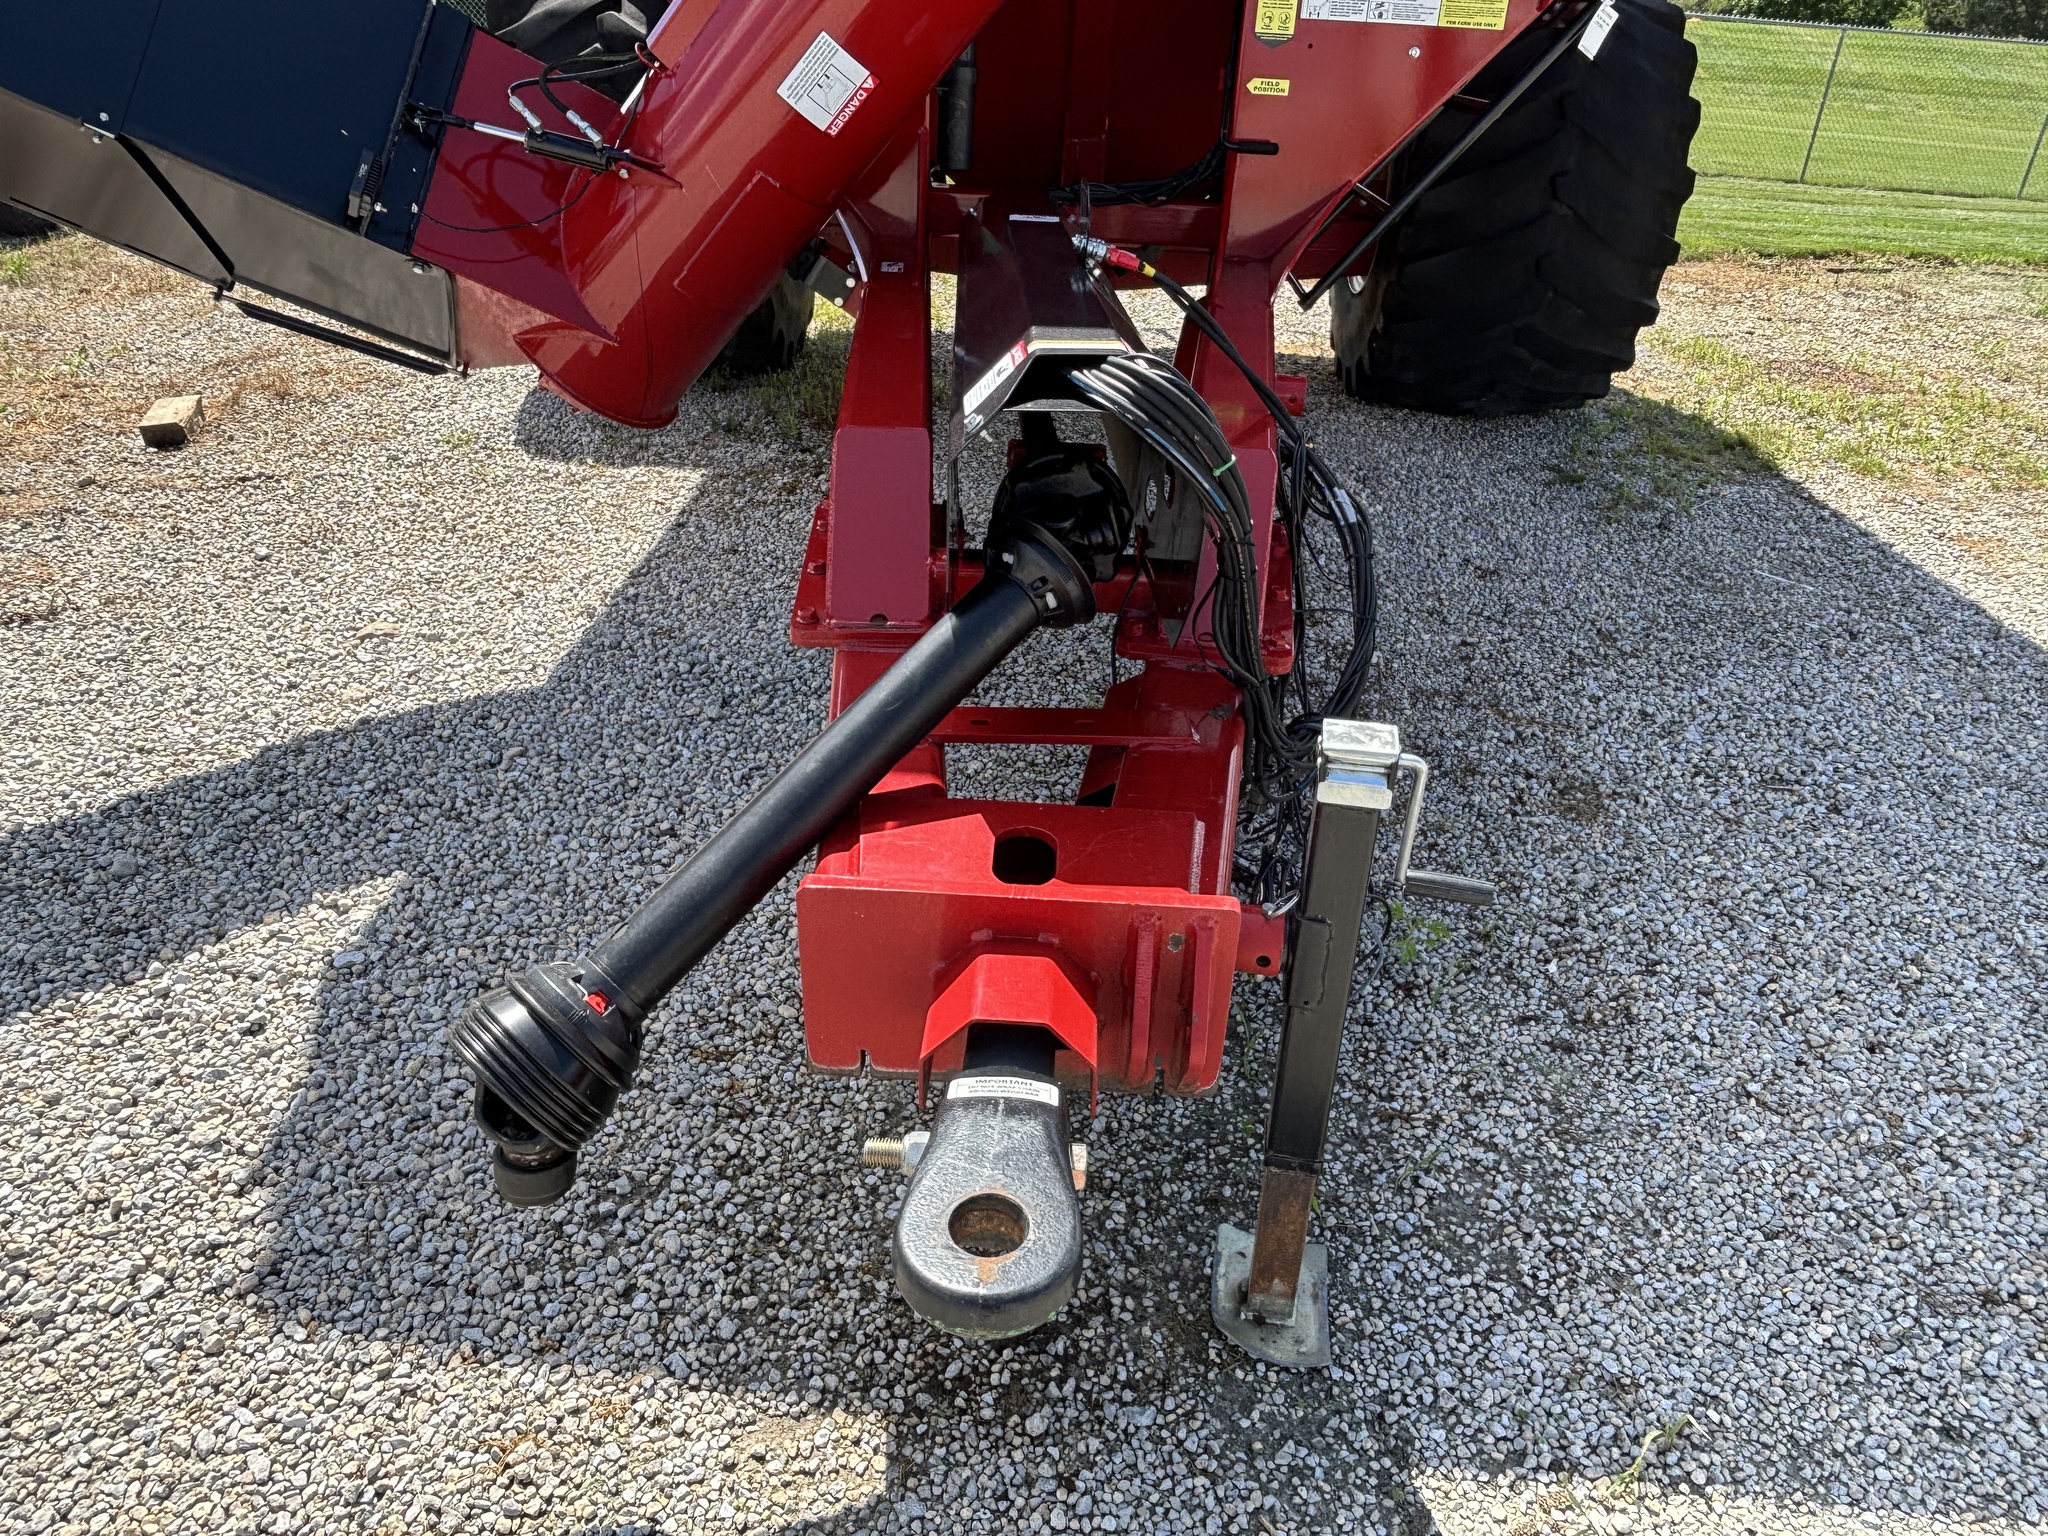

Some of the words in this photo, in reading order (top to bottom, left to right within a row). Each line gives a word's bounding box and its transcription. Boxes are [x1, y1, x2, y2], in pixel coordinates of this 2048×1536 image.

[1253, 86, 1286, 94] POSITION
[826, 89, 868, 137] DANGER
[975, 1079, 1033, 1087] IMPORTANT
